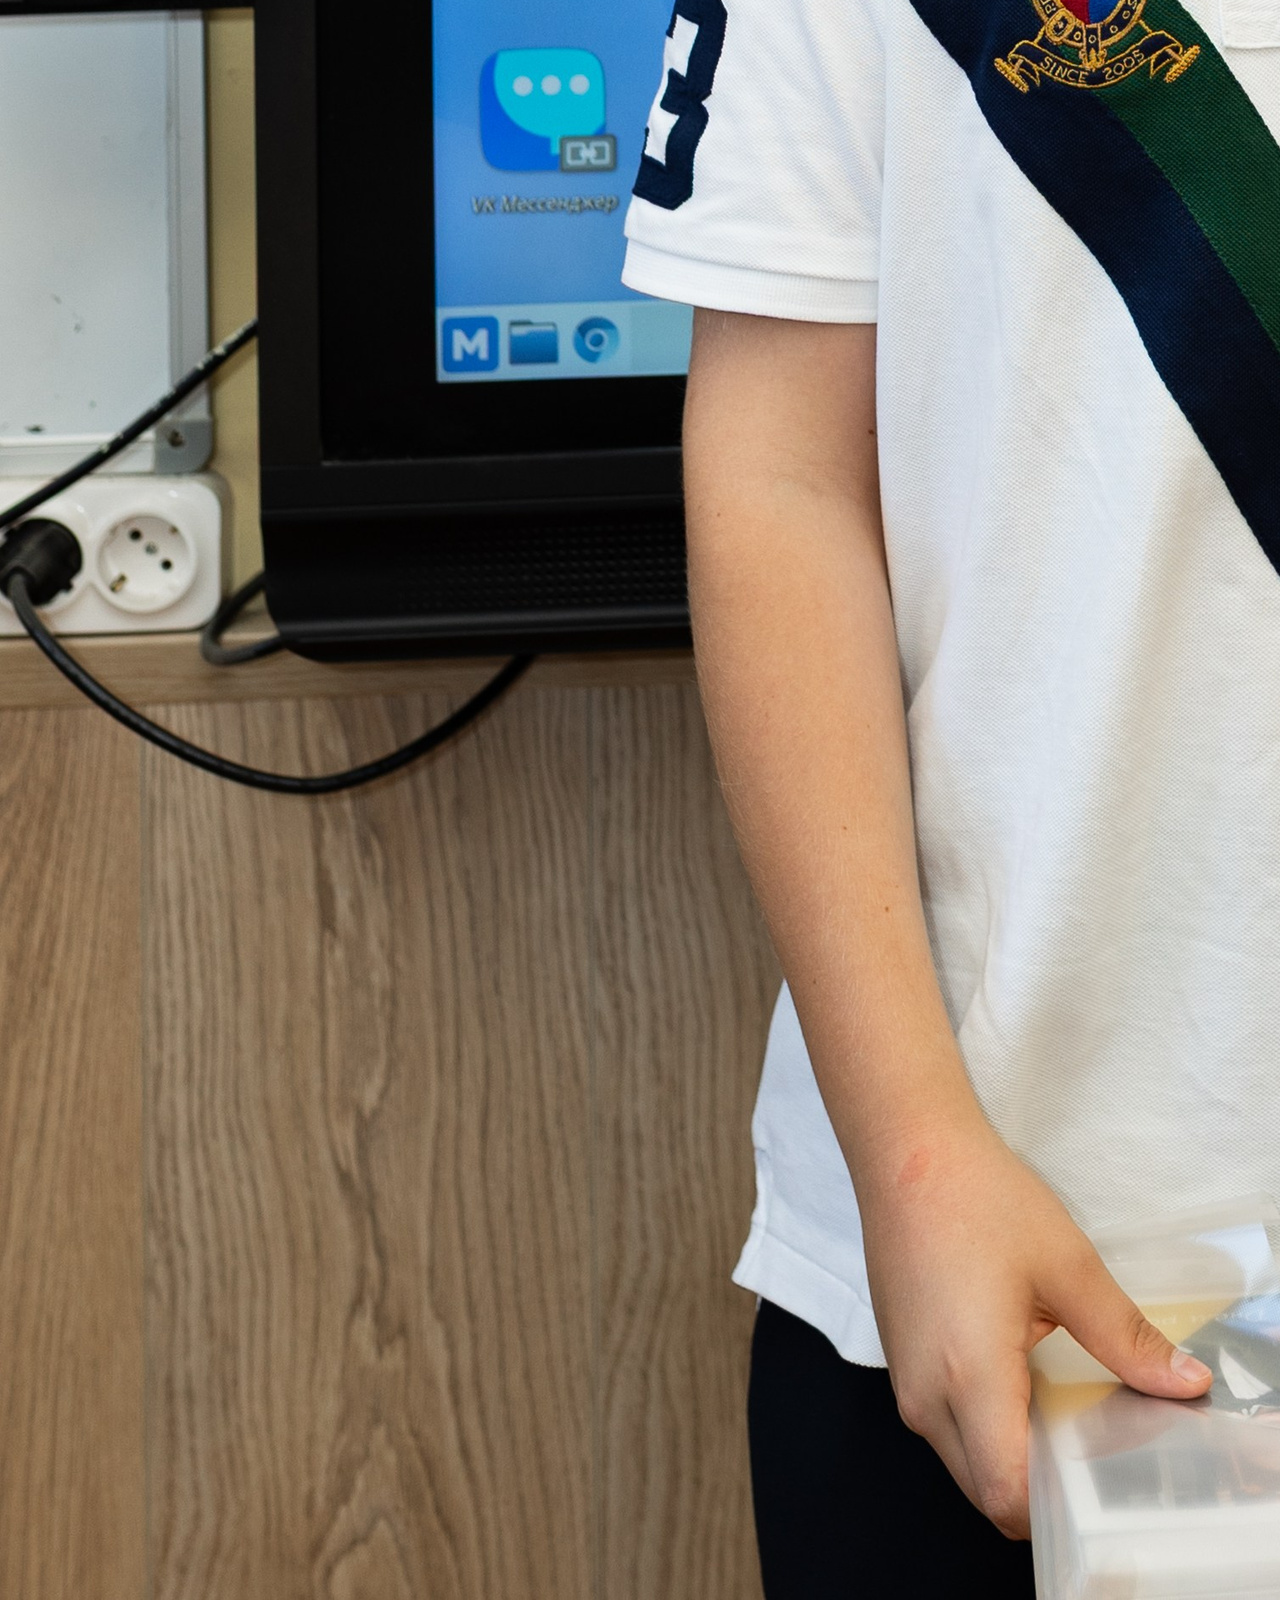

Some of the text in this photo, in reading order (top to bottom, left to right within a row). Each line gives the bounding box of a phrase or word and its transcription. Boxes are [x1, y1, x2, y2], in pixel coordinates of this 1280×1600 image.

[1040, 49, 1144, 83] SINCE 2005
[471, 194, 619, 214] VK Мессенджер
